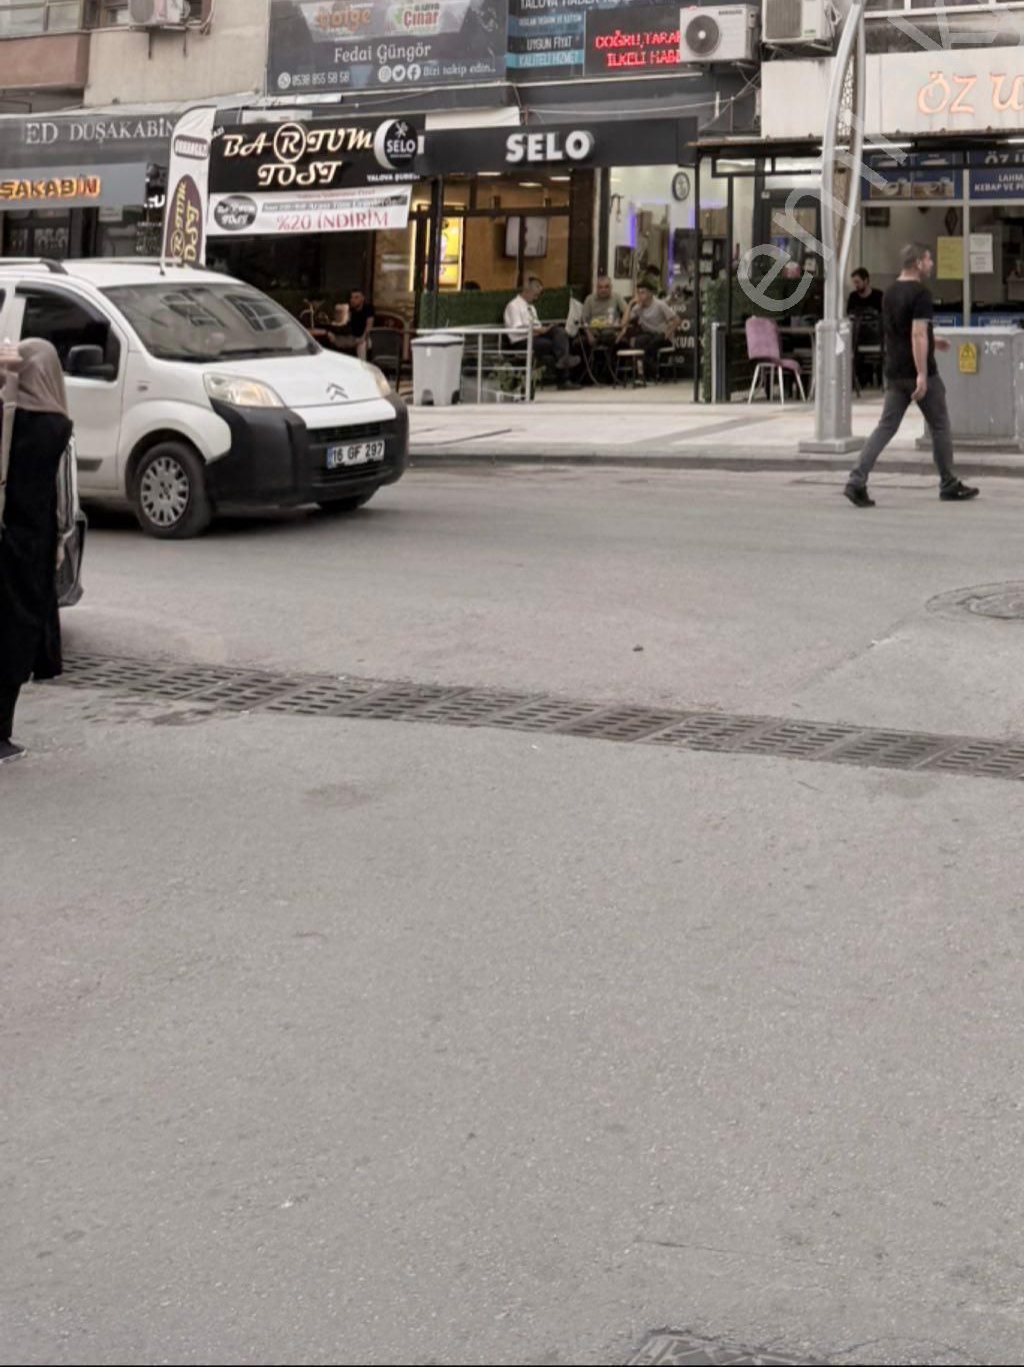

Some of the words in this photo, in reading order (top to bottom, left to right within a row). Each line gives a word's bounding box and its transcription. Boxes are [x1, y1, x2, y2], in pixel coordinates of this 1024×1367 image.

[334, 47, 372, 63] Fedai
[376, 44, 432, 64] Güngör
[917, 70, 978, 114] ÖZ
[386, 139, 416, 153] SELO
[505, 130, 592, 162] SELO
[258, 161, 342, 186] TOST
[277, 214, 311, 230] %20
[333, 447, 343, 462] 16
[347, 445, 362, 460] GF
[365, 442, 383, 459] 297
